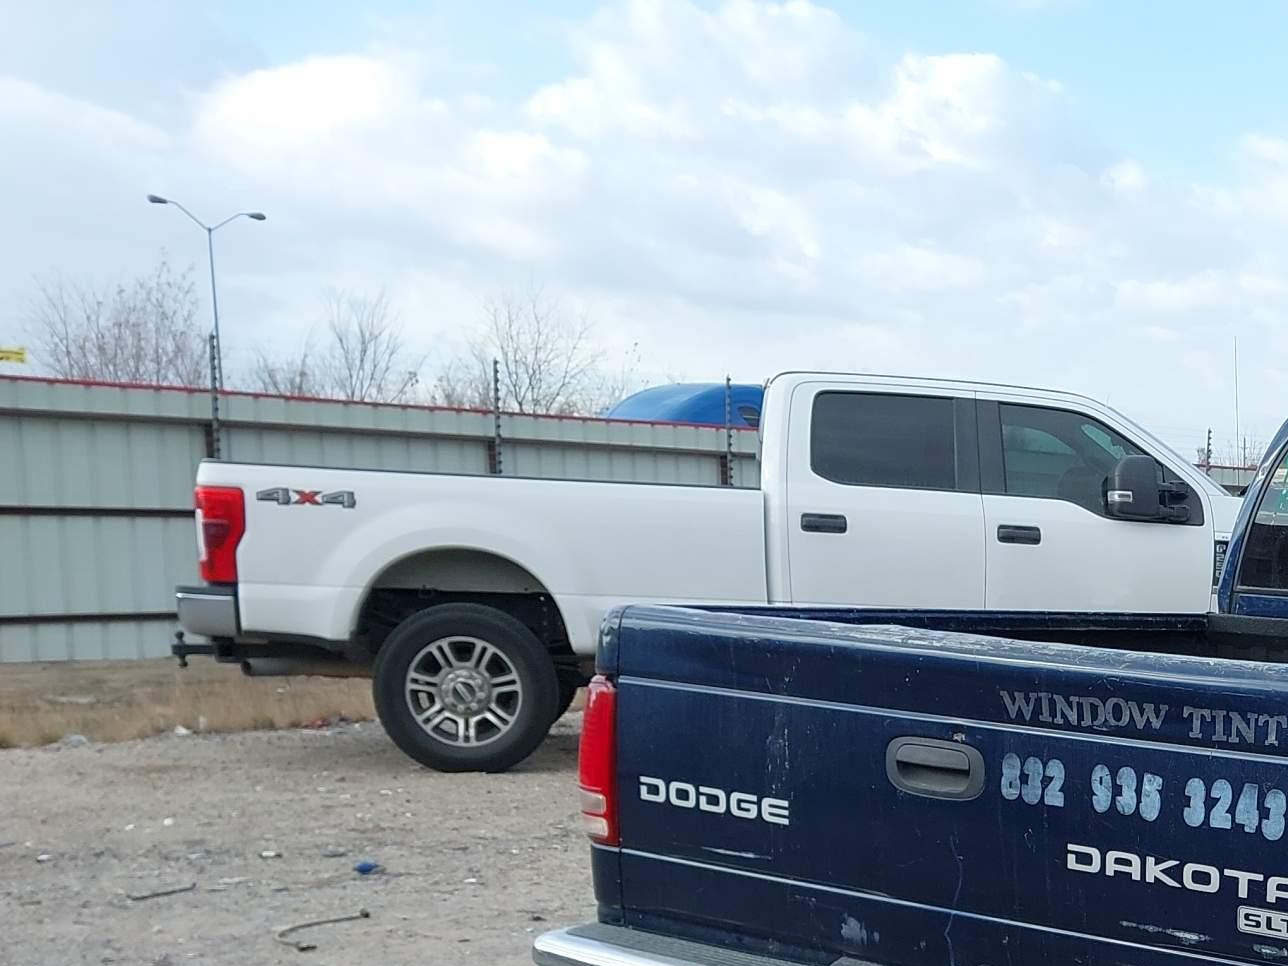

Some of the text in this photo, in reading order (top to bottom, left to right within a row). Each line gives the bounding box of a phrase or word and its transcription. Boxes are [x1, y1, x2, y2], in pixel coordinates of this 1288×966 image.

[1000, 690, 1288, 746] WINDOW TINT
[638, 775, 790, 826] DODGE
[1000, 752, 1287, 841] 832 935 3243
